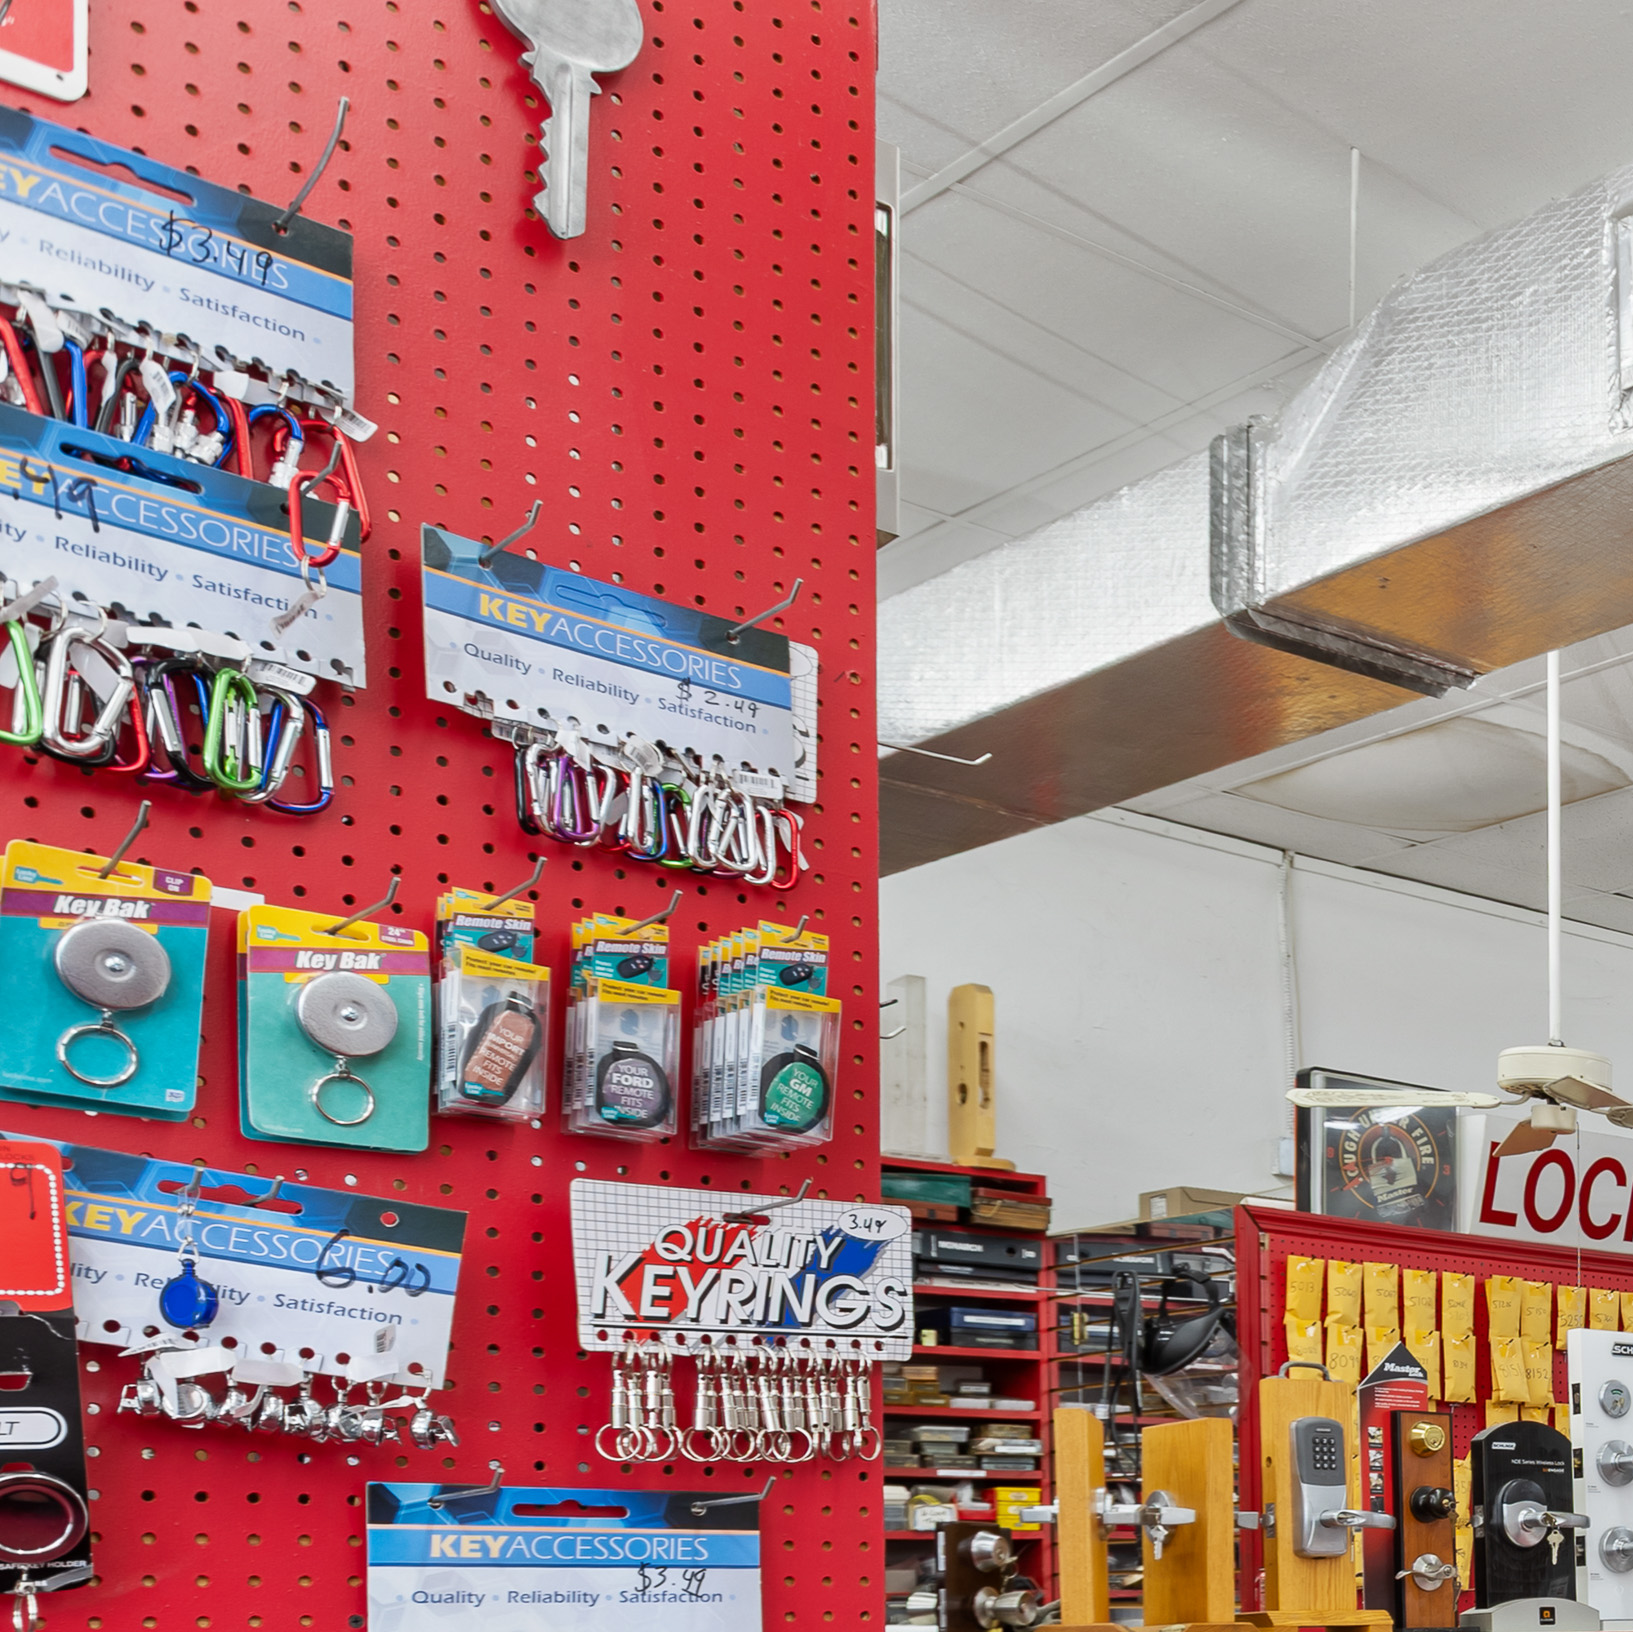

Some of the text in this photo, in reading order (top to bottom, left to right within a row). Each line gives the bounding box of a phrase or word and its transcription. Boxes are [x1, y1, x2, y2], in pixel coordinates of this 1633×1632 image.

[159, 209, 274, 286] $3.49
[39, 238, 306, 342] Reliability Satisfaction
[55, 535, 318, 620] Reliability Satisfactin
[463, 642, 757, 736] Quality Reliability Satisfaction
[53, 895, 152, 920] Key Bak
[455, 915, 532, 932] Remote Skin
[596, 941, 667, 955] Remote Skin
[761, 947, 827, 964] Remote Skin
[295, 951, 381, 971] Key Bak
[488, 1032, 526, 1057] IMPORT
[611, 1073, 654, 1089] FORD
[618, 1063, 649, 1077] YOUR
[793, 1067, 819, 1089] YOUR
[610, 1084, 655, 1100] REMOTE
[776, 1083, 815, 1111] REMOTE
[789, 1078, 813, 1098] GM
[620, 1096, 643, 1108] FITS
[780, 1096, 801, 1114] FITS
[653, 1223, 846, 1270] QUALITY
[315, 1228, 432, 1297] 6.00
[589, 1249, 908, 1332] KEYRINGS
[272, 1292, 403, 1326] Satisfaction
[1383, 1362, 1421, 1375] Master
[636, 1562, 708, 1599] $3.49
[411, 1589, 724, 1608] Quality Reliability Satisfaction
